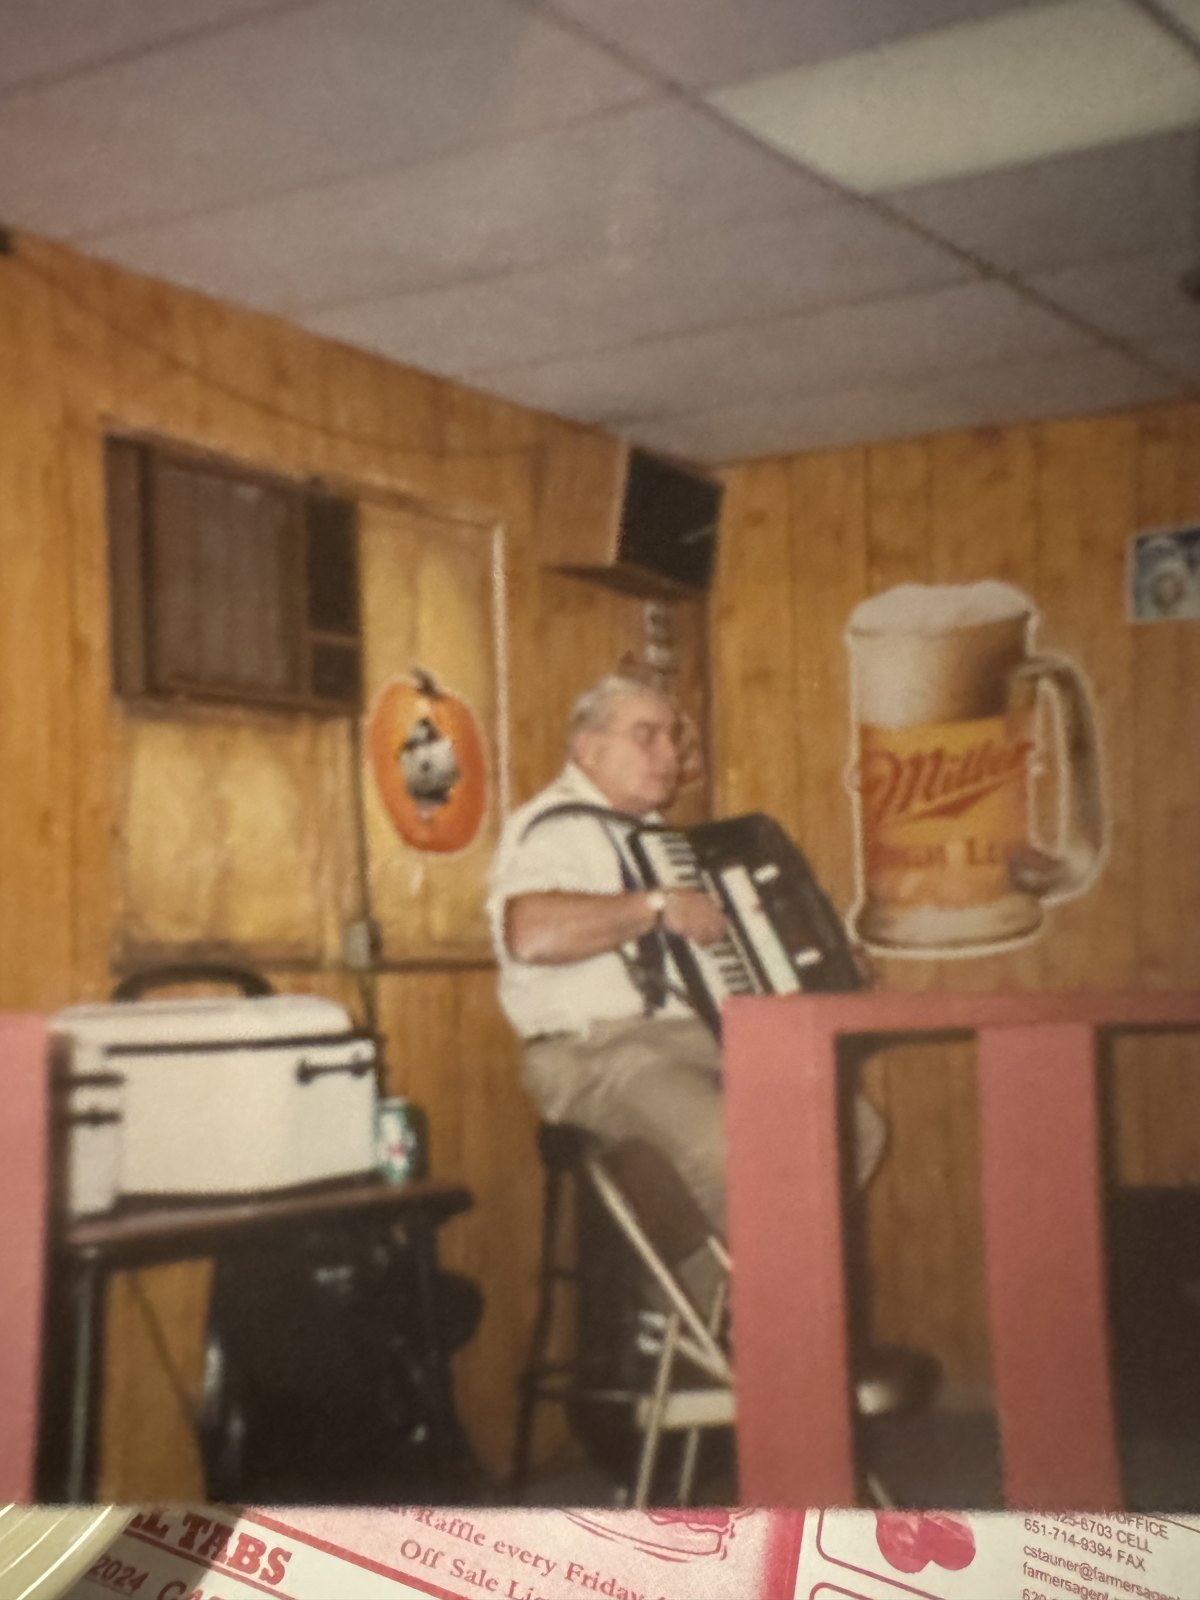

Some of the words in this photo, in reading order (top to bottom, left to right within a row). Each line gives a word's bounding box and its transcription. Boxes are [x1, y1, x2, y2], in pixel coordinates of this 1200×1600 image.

[178, 1511, 292, 1586] TABS
[413, 1506, 487, 1547] Raffle
[493, 1540, 557, 1577] every
[1116, 1529, 1153, 1554] CELL
[1117, 1549, 1146, 1572] FAX
[92, 1555, 149, 1592] 2024
[400, 1538, 446, 1569] Off
[450, 1558, 499, 1592] Sale
